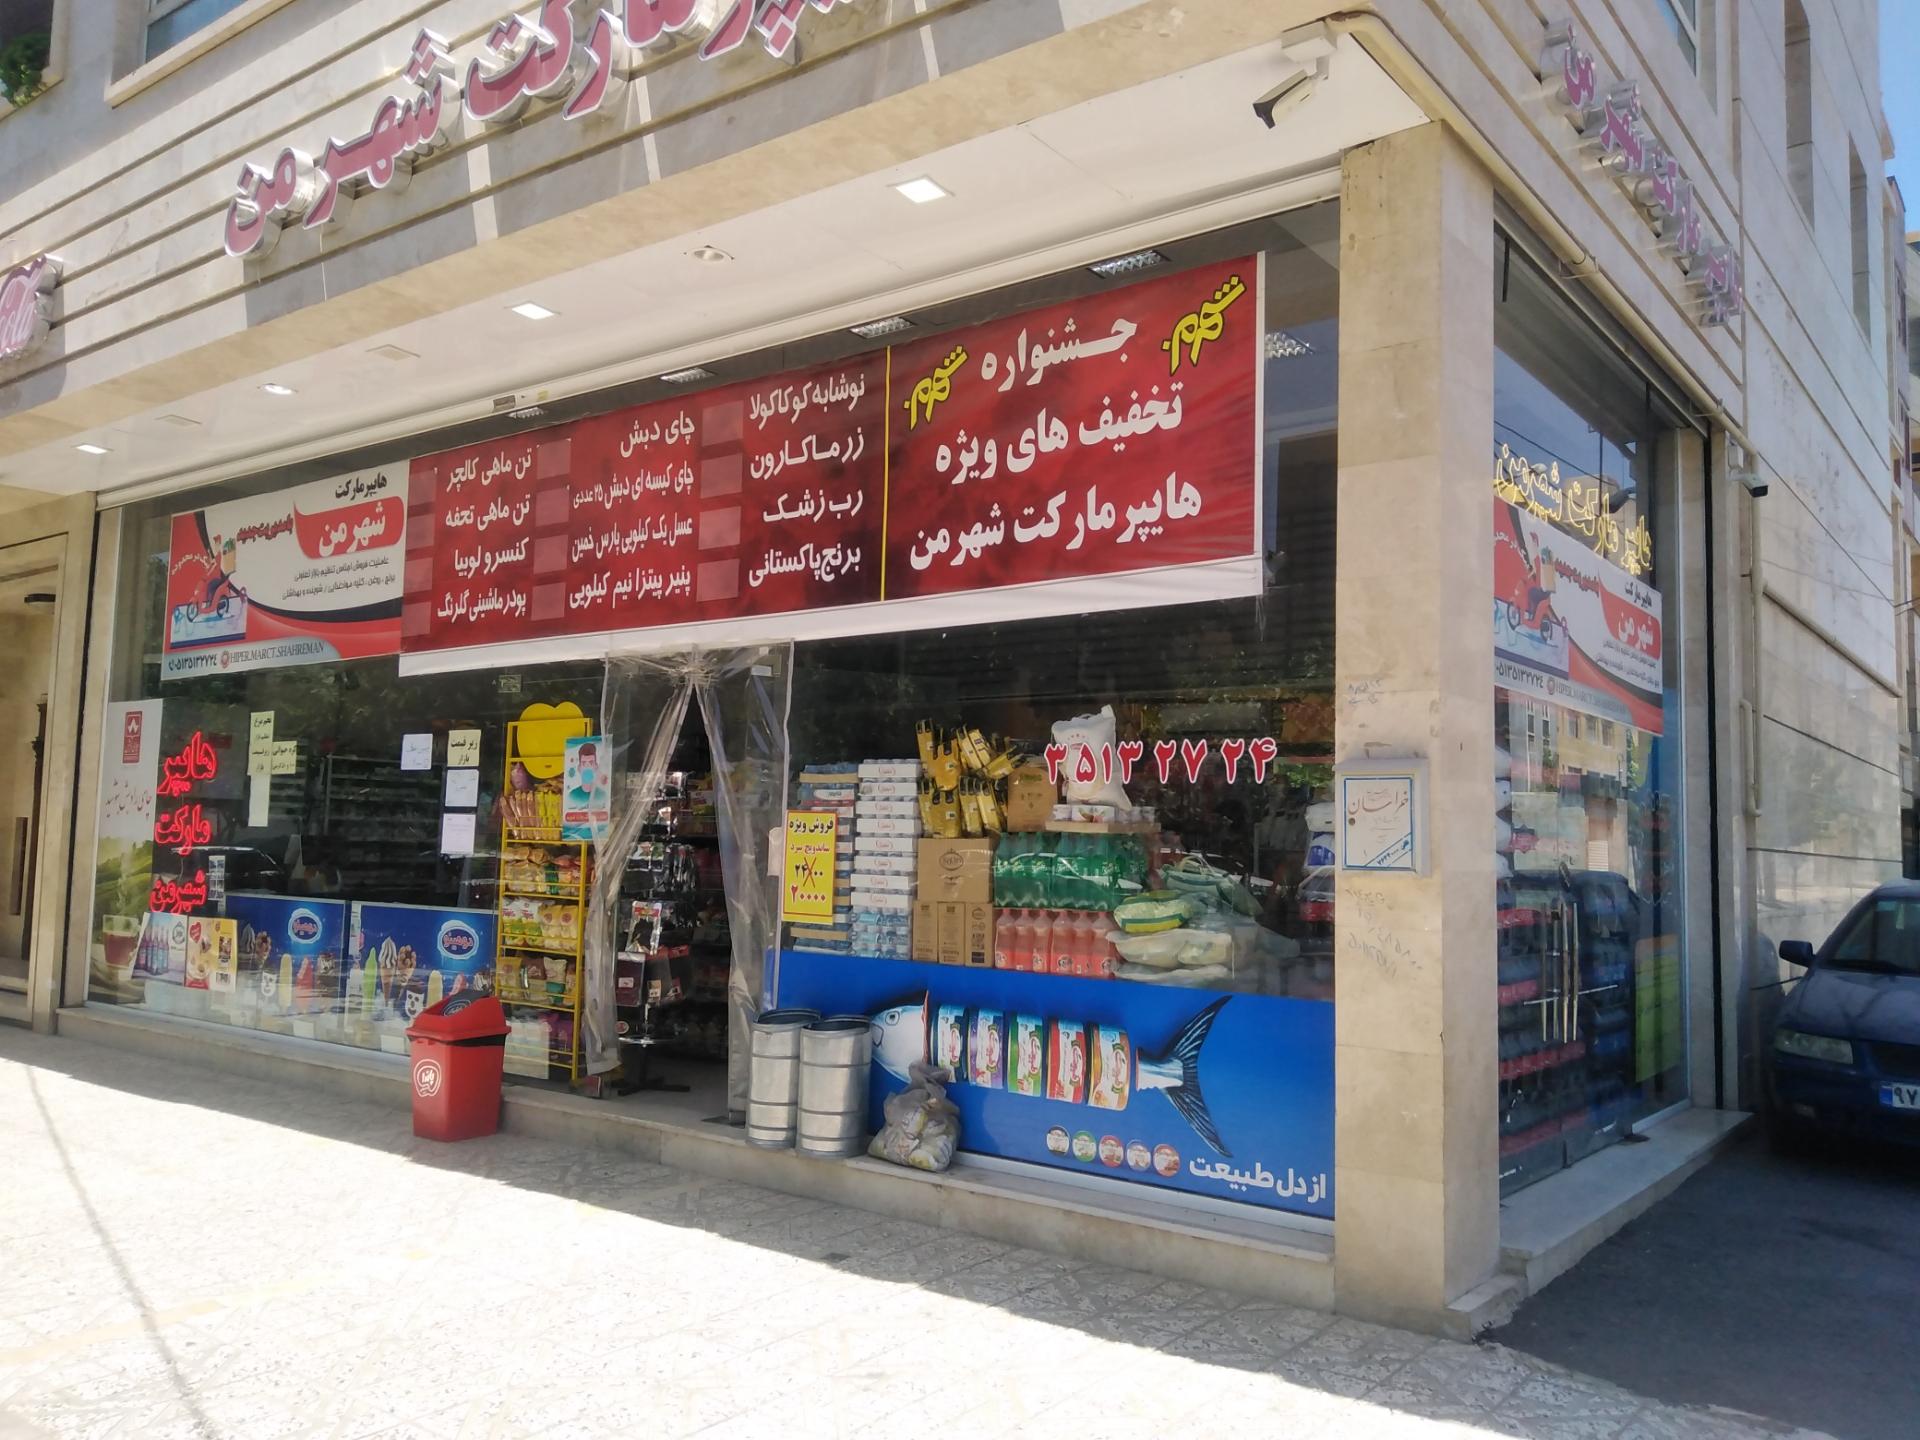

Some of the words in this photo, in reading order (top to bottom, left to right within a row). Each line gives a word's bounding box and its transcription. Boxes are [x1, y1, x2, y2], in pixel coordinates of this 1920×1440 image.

[303, 28, 458, 229] شهر
[223, 147, 314, 258] من
[980, 316, 1138, 393] جشنواره
[811, 373, 865, 411] نوشابه
[664, 410, 696, 445] چای
[1078, 380, 1184, 452] تخفیف
[620, 419, 661, 458] دبش
[842, 426, 865, 462] زر
[1006, 407, 1069, 473] های
[481, 451, 512, 486] ماهی
[514, 448, 532, 480] تن
[750, 433, 840, 480] ماکارون
[935, 428, 998, 485] ویژه
[335, 478, 364, 500] مارکت
[363, 472, 388, 497] هایپر
[446, 457, 480, 493] کالچر
[594, 482, 604, 502] ۲۵
[603, 472, 630, 510] دبش
[631, 469, 644, 500] ای
[645, 462, 673, 496] کیسه
[673, 460, 695, 496] چای
[476, 497, 510, 531] ماهی
[512, 494, 531, 526] تن
[573, 487, 594, 510] عددی
[763, 489, 826, 523] زشک
[828, 489, 864, 519] رب
[1115, 471, 1203, 543] هایپر
[347, 501, 387, 554] شهر
[445, 505, 475, 528] تحفه
[652, 516, 667, 541] یک
[669, 512, 693, 547] عسل
[949, 502, 1005, 566] شهر
[1013, 484, 1115, 550] مارکت
[318, 520, 348, 558] من
[595, 522, 621, 559] پارس
[621, 516, 651, 555] کیلویی
[909, 524, 951, 570] من
[454, 545, 482, 579] لوبیا
[483, 537, 531, 575] کنسرو
[748, 542, 821, 588] پاکستانی
[821, 545, 862, 582] برنج
[569, 571, 610, 610] کیلویی
[612, 578, 633, 609] نیم
[635, 567, 663, 600] پیتزا
[664, 564, 692, 597] پنیر
[437, 588, 470, 624] گلرنگ
[468, 587, 504, 622] ماشینی
[503, 589, 527, 618] پودر
[1618, 611, 1635, 643] من
[156, 729, 218, 797] هایپر
[154, 802, 213, 857] مارکت
[789, 818, 807, 833] ویژه
[808, 817, 834, 834] فروش
[790, 843, 803, 854] سرد
[804, 843, 830, 855] ساندویچ
[1189, 1157, 1275, 1192] طبیعت
[1276, 1167, 1307, 1198] دل
[1307, 1173, 1327, 1204] از
